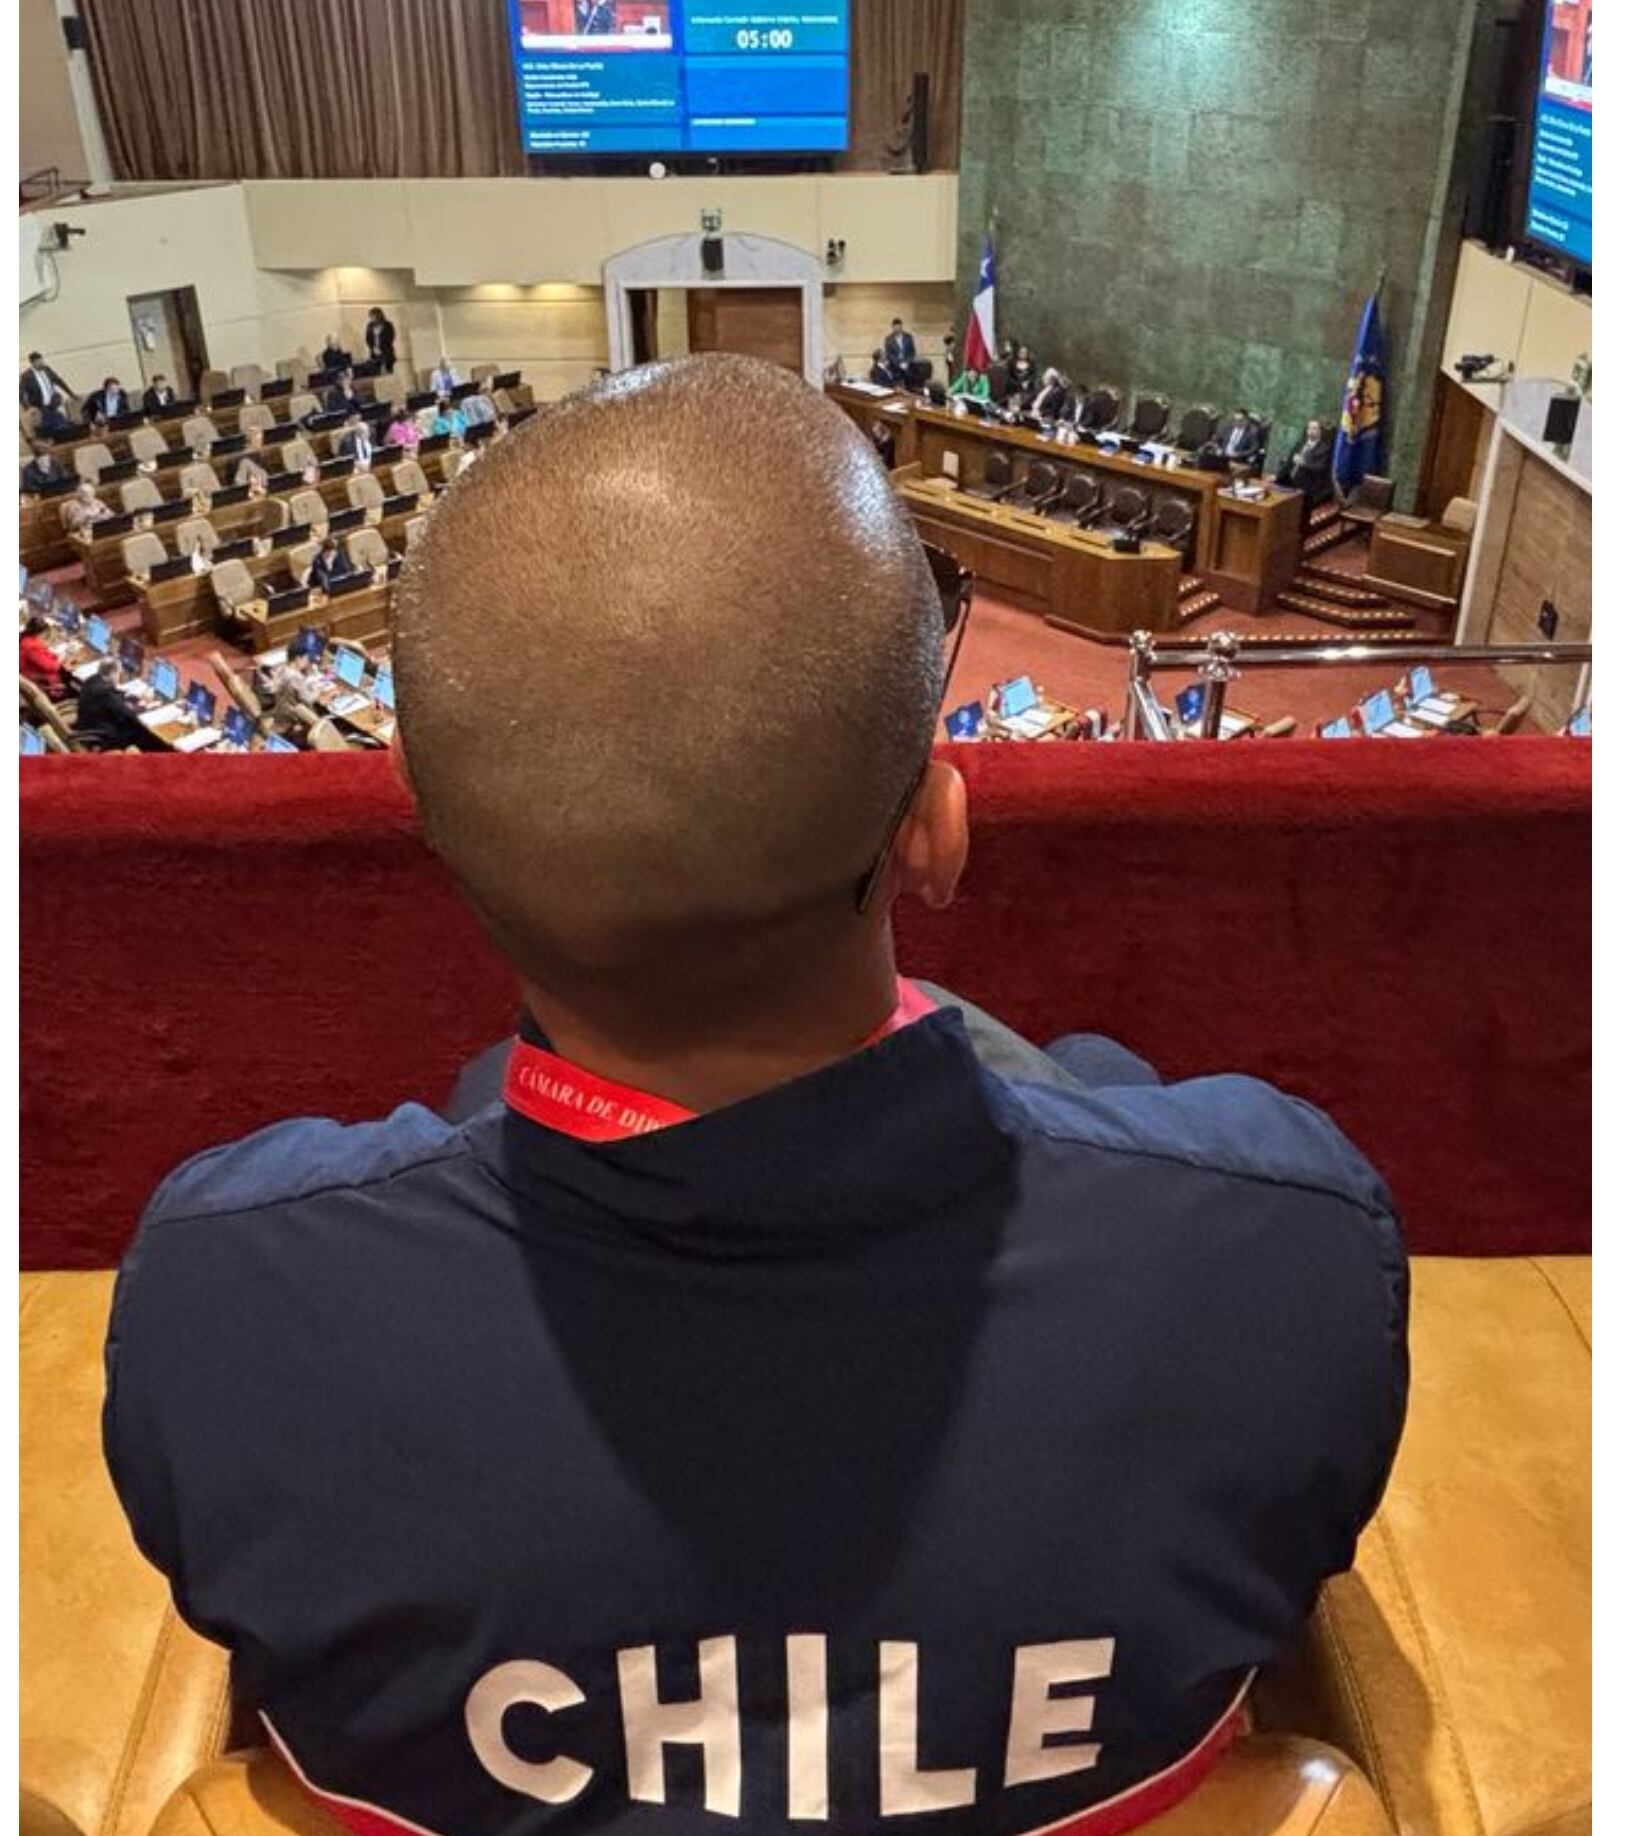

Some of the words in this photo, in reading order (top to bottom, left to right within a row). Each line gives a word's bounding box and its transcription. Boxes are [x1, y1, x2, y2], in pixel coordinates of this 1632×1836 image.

[736, 29, 793, 49] 05:00
[586, 1096, 615, 1117] DE
[465, 1633, 1115, 1820] CHILE
